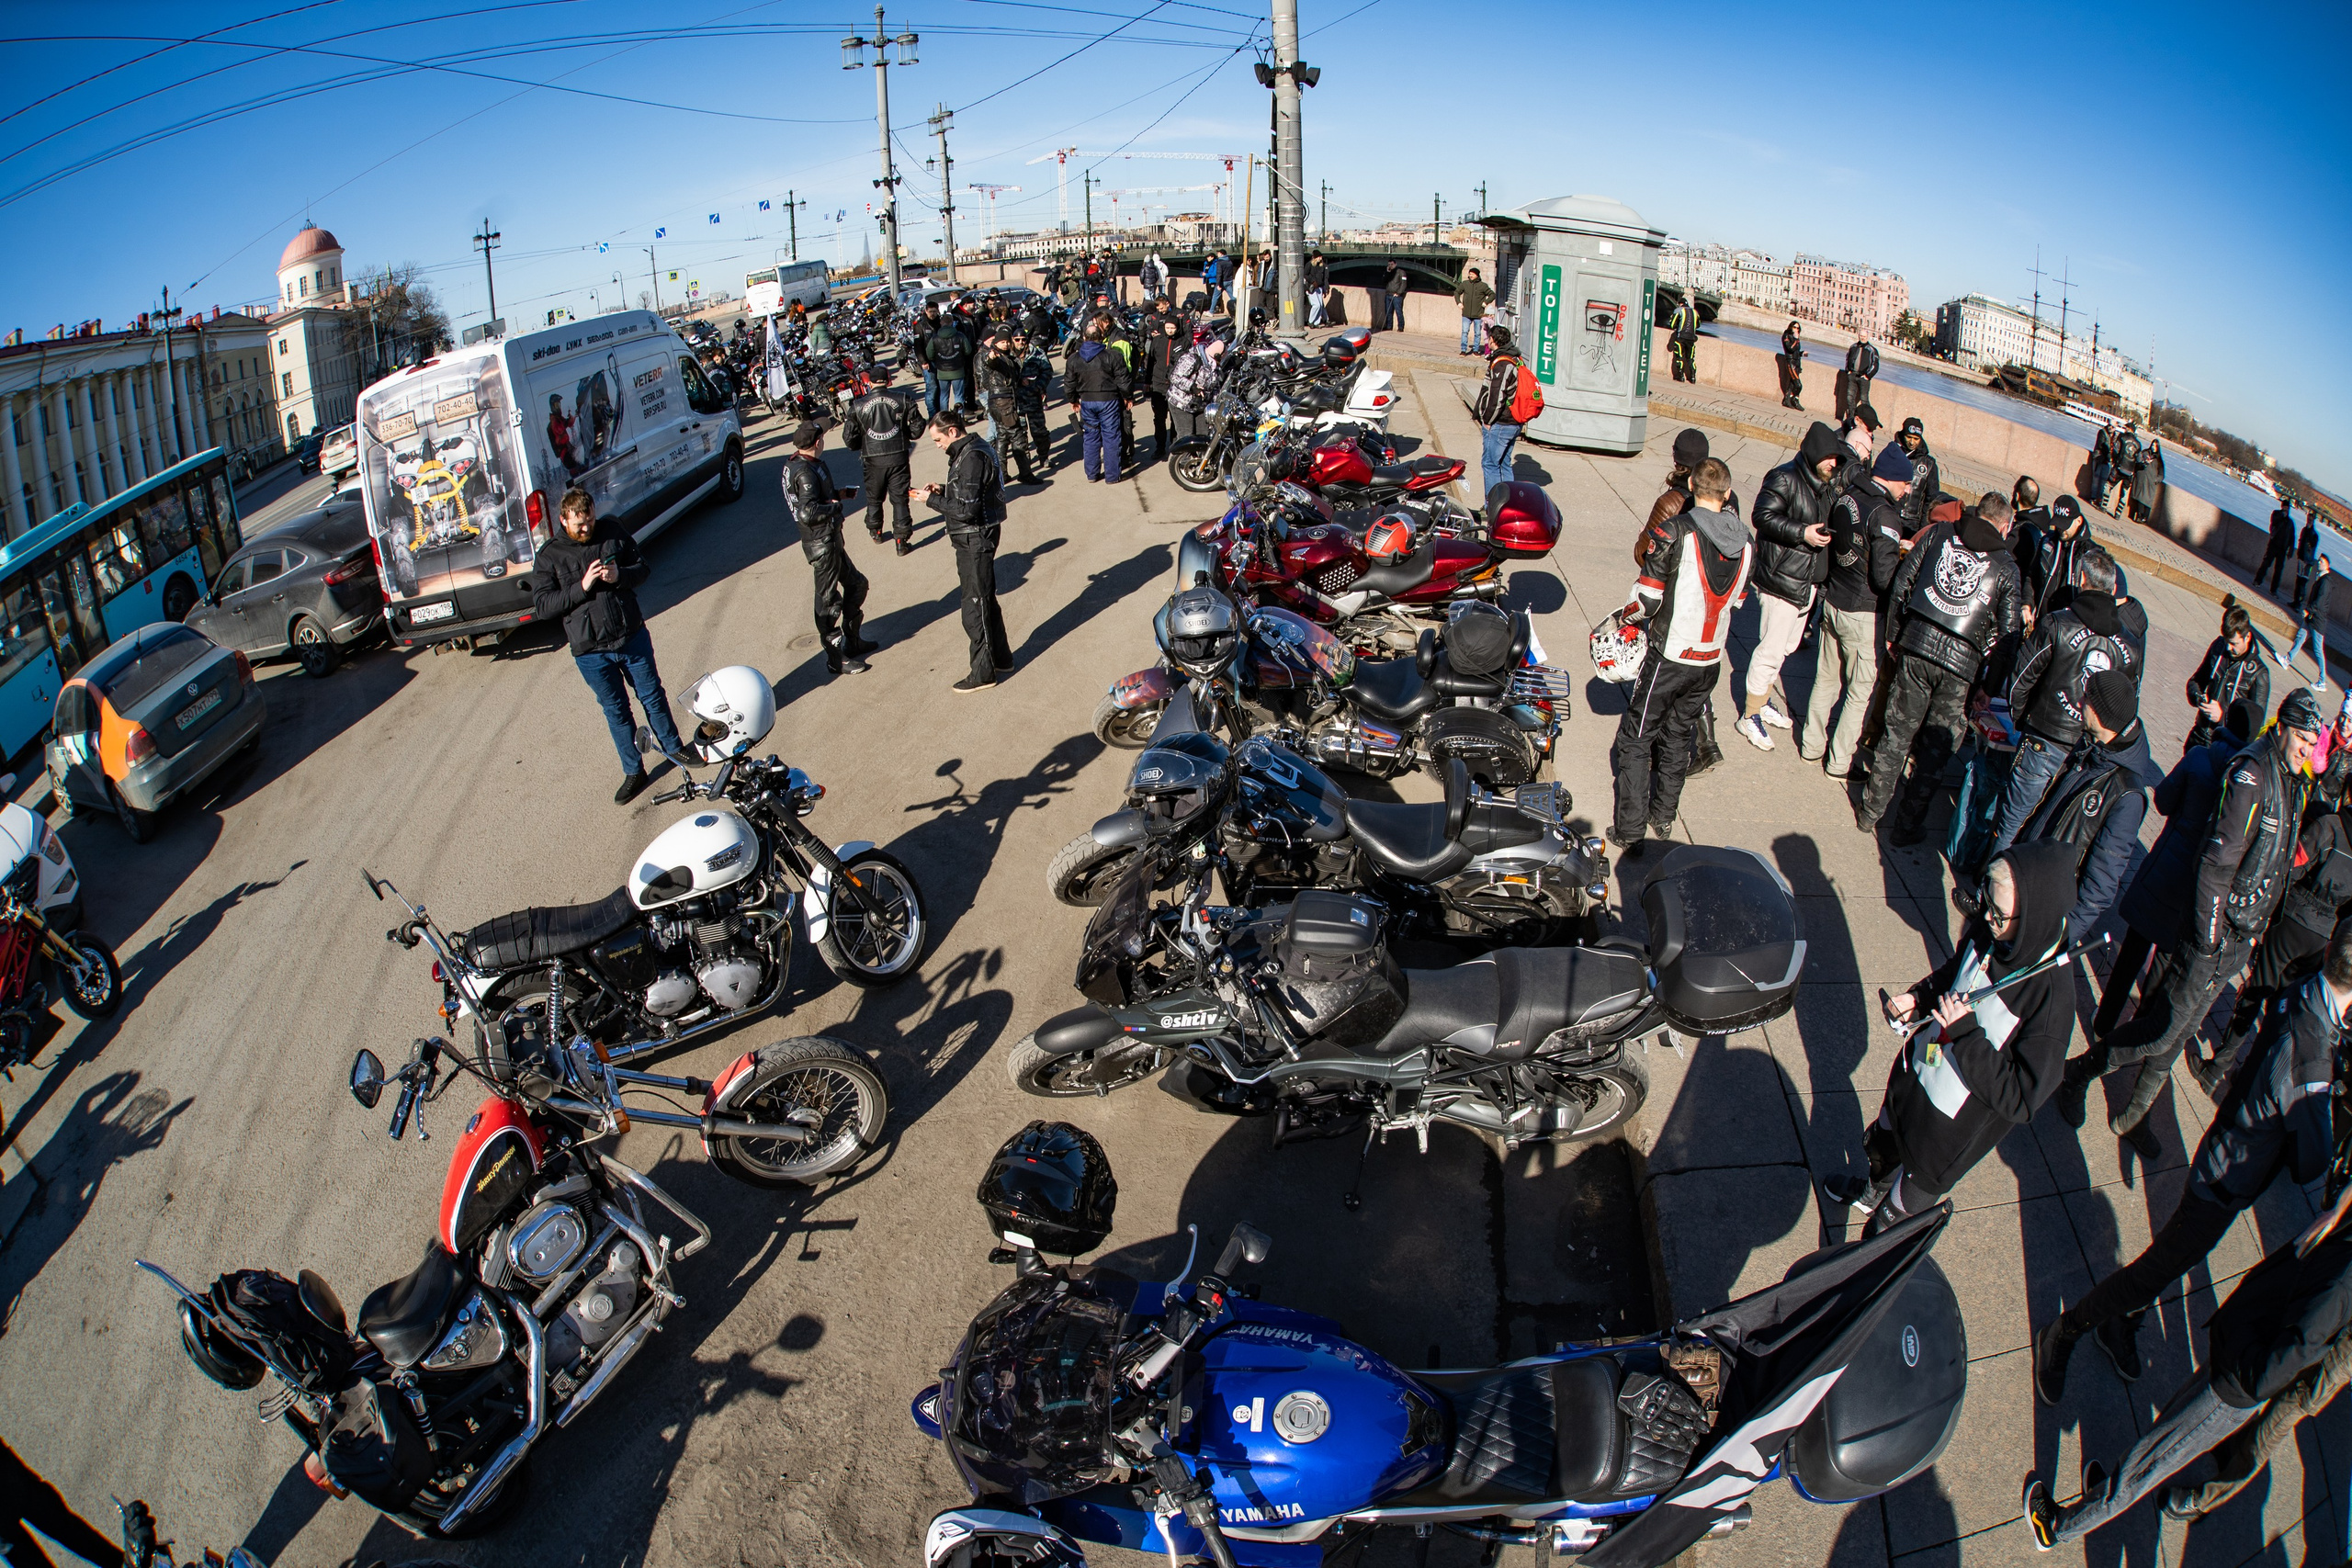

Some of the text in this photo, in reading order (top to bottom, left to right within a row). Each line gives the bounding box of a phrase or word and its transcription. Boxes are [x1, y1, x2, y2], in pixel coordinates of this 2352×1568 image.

[1542, 278, 1556, 370] TOILET
[1615, 305, 1627, 342] OPEN
[1640, 293, 1652, 382] TOILET
[533, 344, 560, 361] ski-doo
[566, 338, 582, 351] LYNX
[633, 367, 663, 389] VETERR
[437, 396, 474, 413] 702-40-40
[639, 387, 665, 407] VETERR.COM
[382, 416, 413, 434] 336-70-70
[1932, 596, 1968, 615] PETERSBURG
[1188, 619, 1207, 627] SHOEI
[2069, 629, 2088, 647] THE
[1140, 770, 1159, 781] SHOEI
[2228, 878, 2270, 908] USSIA
[1160, 1011, 1217, 1028] @shtiv
[1738, 1023, 1756, 1032] THE
[1240, 1325, 1313, 1344] YAMAHA
[1906, 1334, 1915, 1357] GIVI
[1219, 1503, 1306, 1522] YAMAHA
